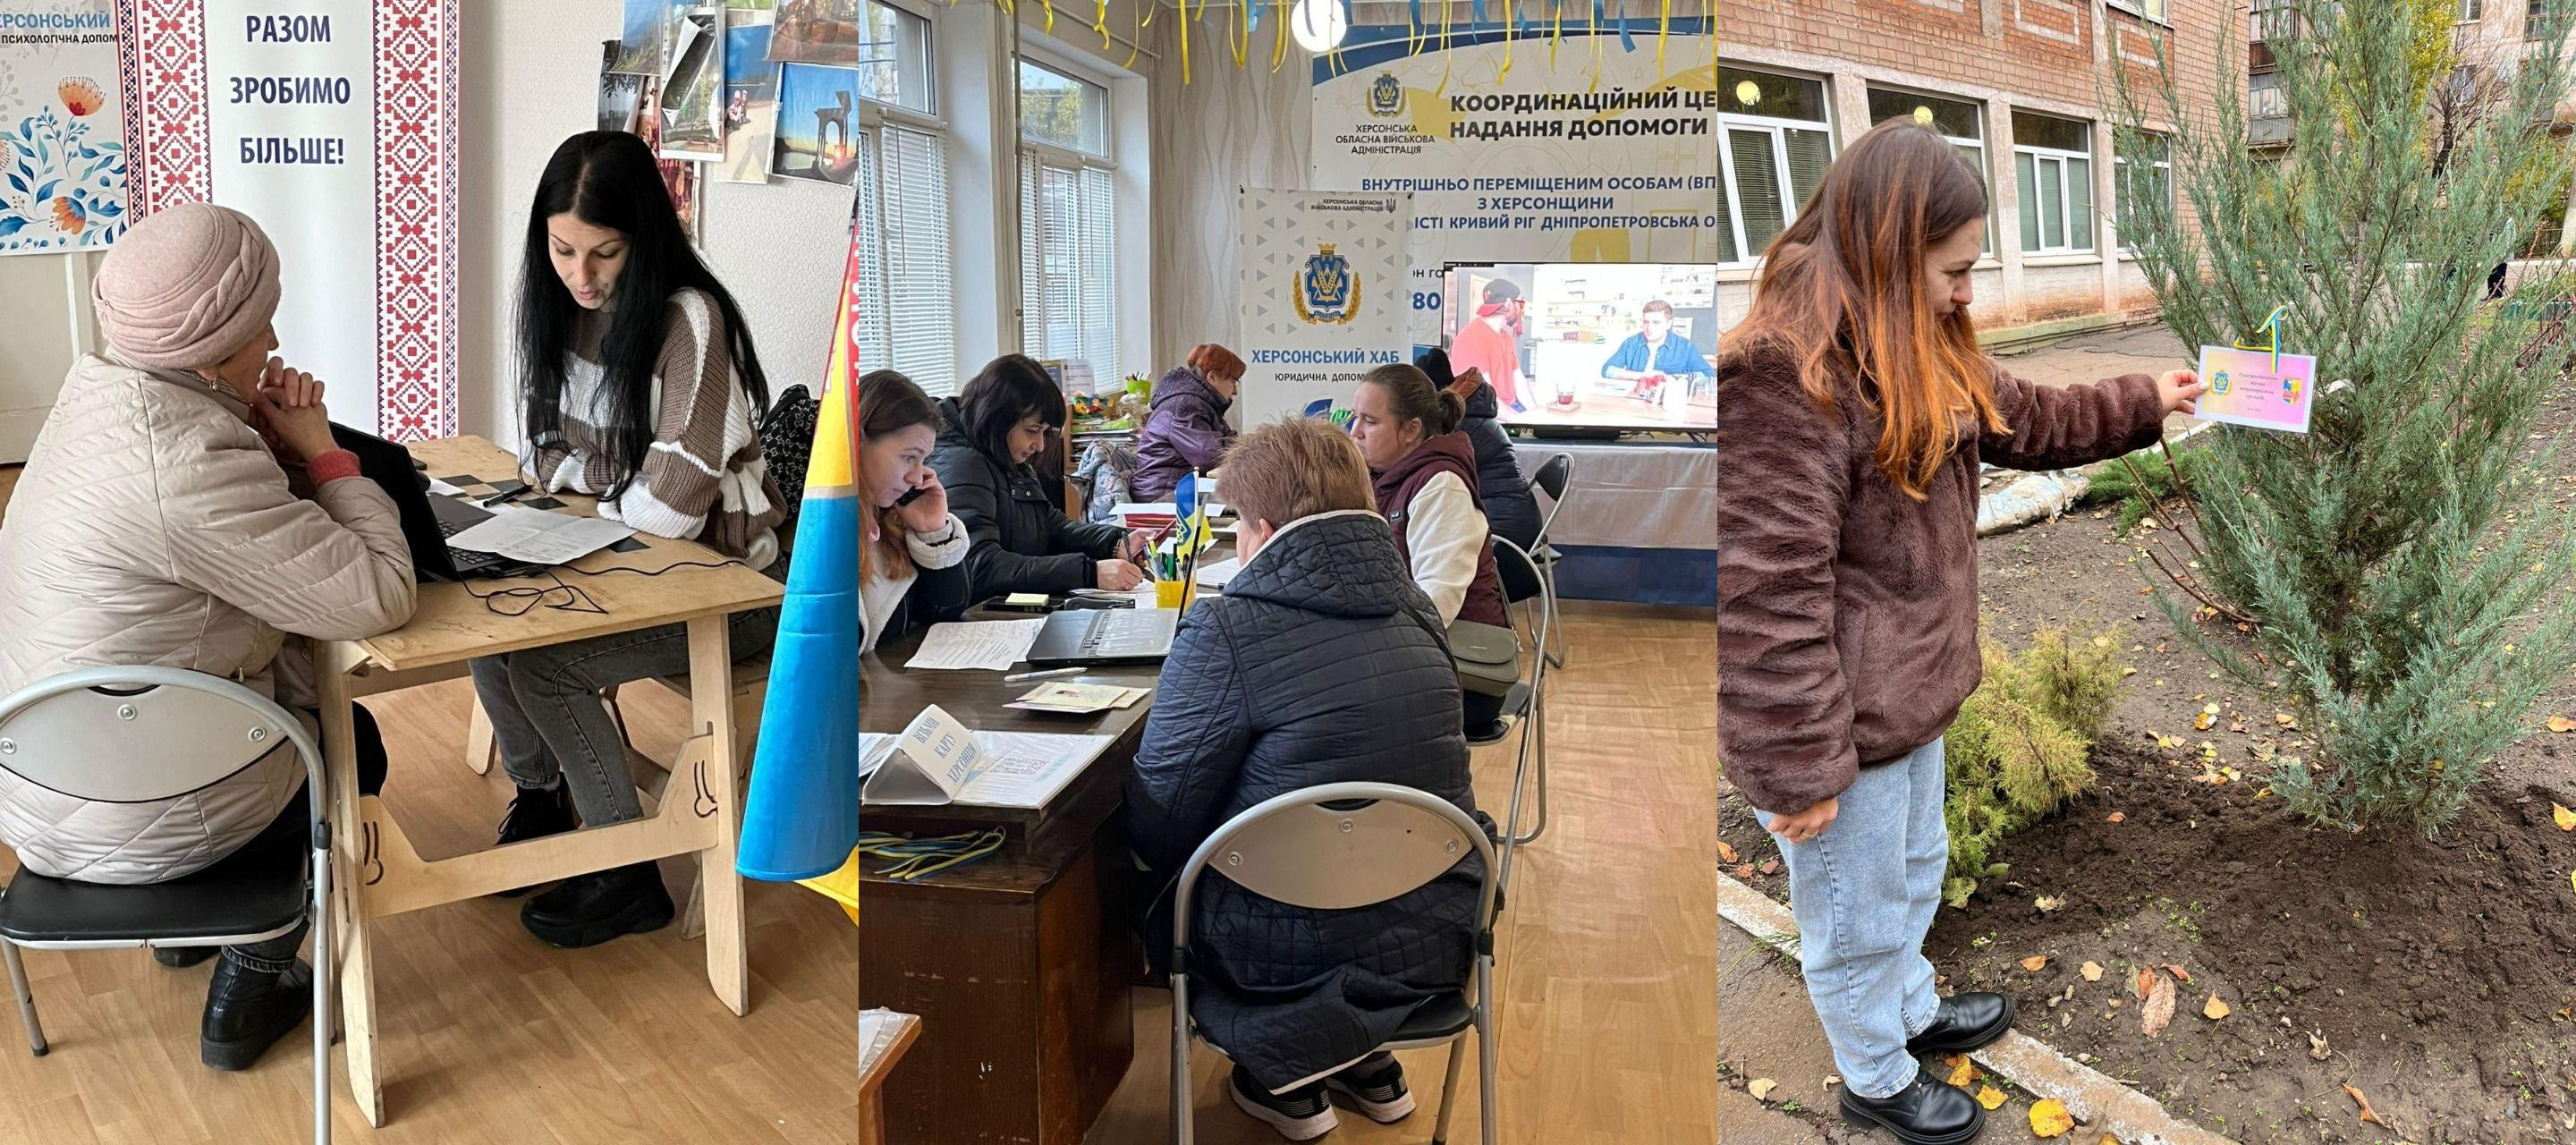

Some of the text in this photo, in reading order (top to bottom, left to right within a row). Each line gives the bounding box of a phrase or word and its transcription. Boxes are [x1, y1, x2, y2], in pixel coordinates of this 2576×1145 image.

[0, 10, 110, 28] РСОНСЬКИЙ
[246, 15, 331, 42] РАЗОМ
[2, 34, 80, 44] ПСИХОЛОГІЧНА
[230, 77, 351, 104] ЗРОБИМО
[1451, 86, 1716, 114] КООРДИНАЦІЙНИЙ ЦЕ
[1355, 124, 1418, 133] ХЕРСОНСЬКА
[1450, 118, 1707, 141] НАДАННЯ ДОПОМОГИ
[1335, 134, 1436, 144] ОБЛАСНА ВІЙСЬКОВА
[240, 137, 344, 165] БІЛЬШЕ!
[1351, 146, 1422, 156] АДМІНІСТРАЦІЯ
[1362, 175, 1716, 193] ВНУТРІШНЬО ПЕРЕМІЩЕНИМ ОСОБАМ (ВП
[1342, 205, 1384, 213] АДМІНІСТРАЦІЯ
[1478, 197, 1614, 212] З ХЕРСОНЩИНИ
[1414, 214, 1717, 231] ІСТІ КРИВИЙ РІГ ДНІПРОПЕТРОВСЬКА О
[1251, 348, 1400, 364] ХЕРСОНСЬКИЙ ХАБ
[1275, 372, 1328, 382] ЮРИДИЧНА
